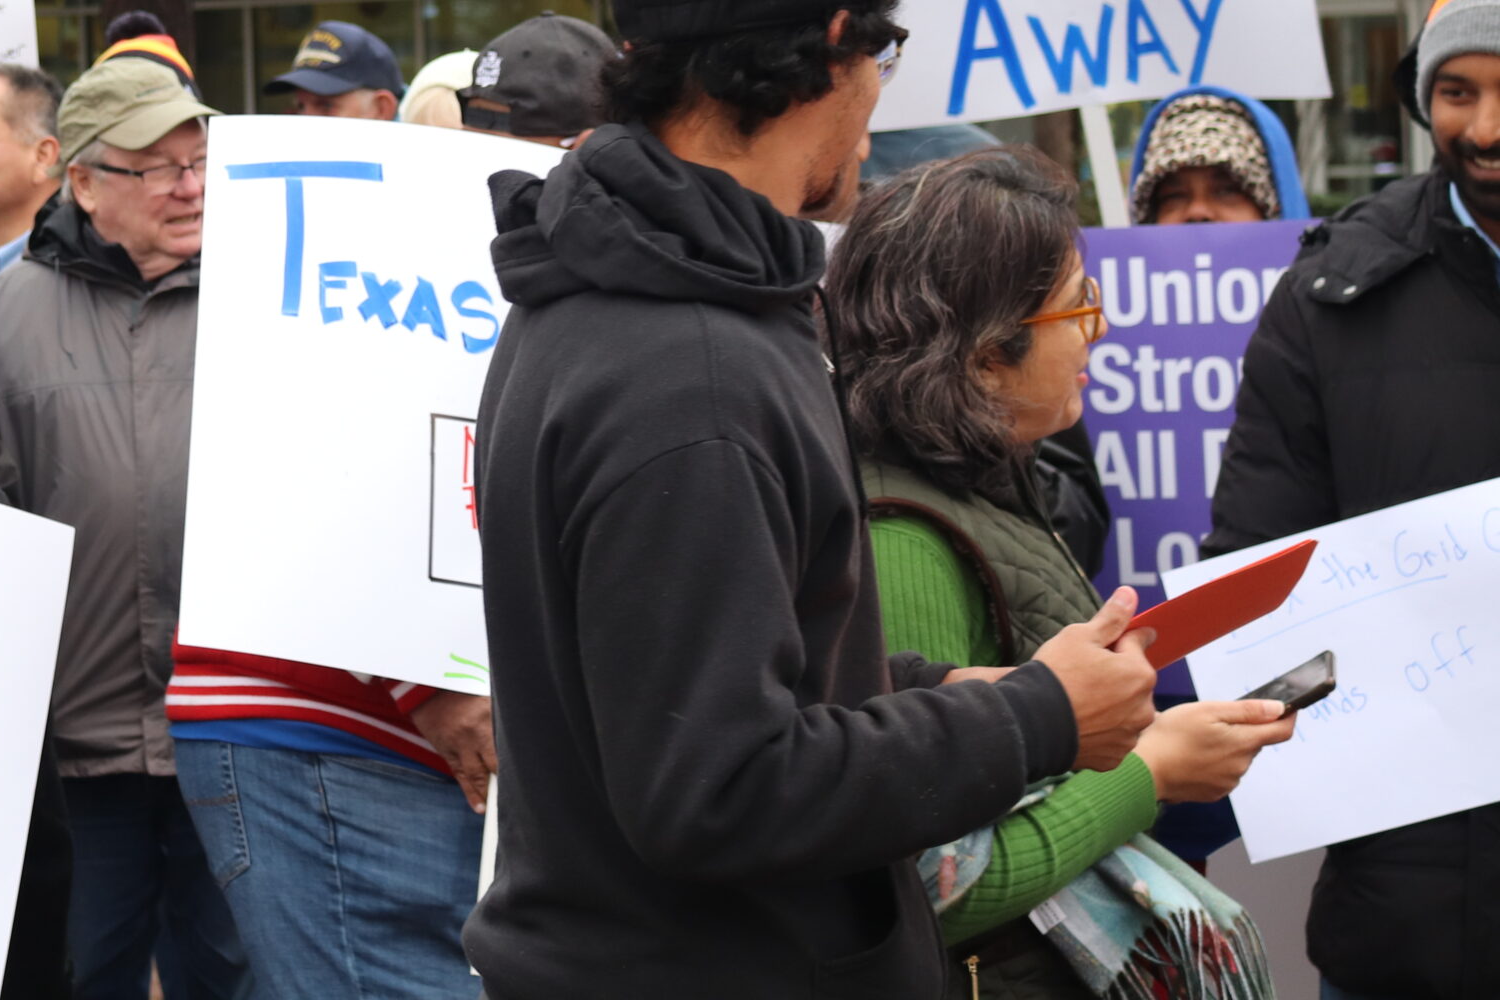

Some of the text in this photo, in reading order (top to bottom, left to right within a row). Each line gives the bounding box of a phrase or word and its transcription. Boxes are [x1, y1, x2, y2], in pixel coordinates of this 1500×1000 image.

[224, 161, 499, 354] TEXAS
[1088, 343, 1244, 414] Stro
[1095, 429, 1177, 499] All
[1393, 523, 1468, 578] Grid
